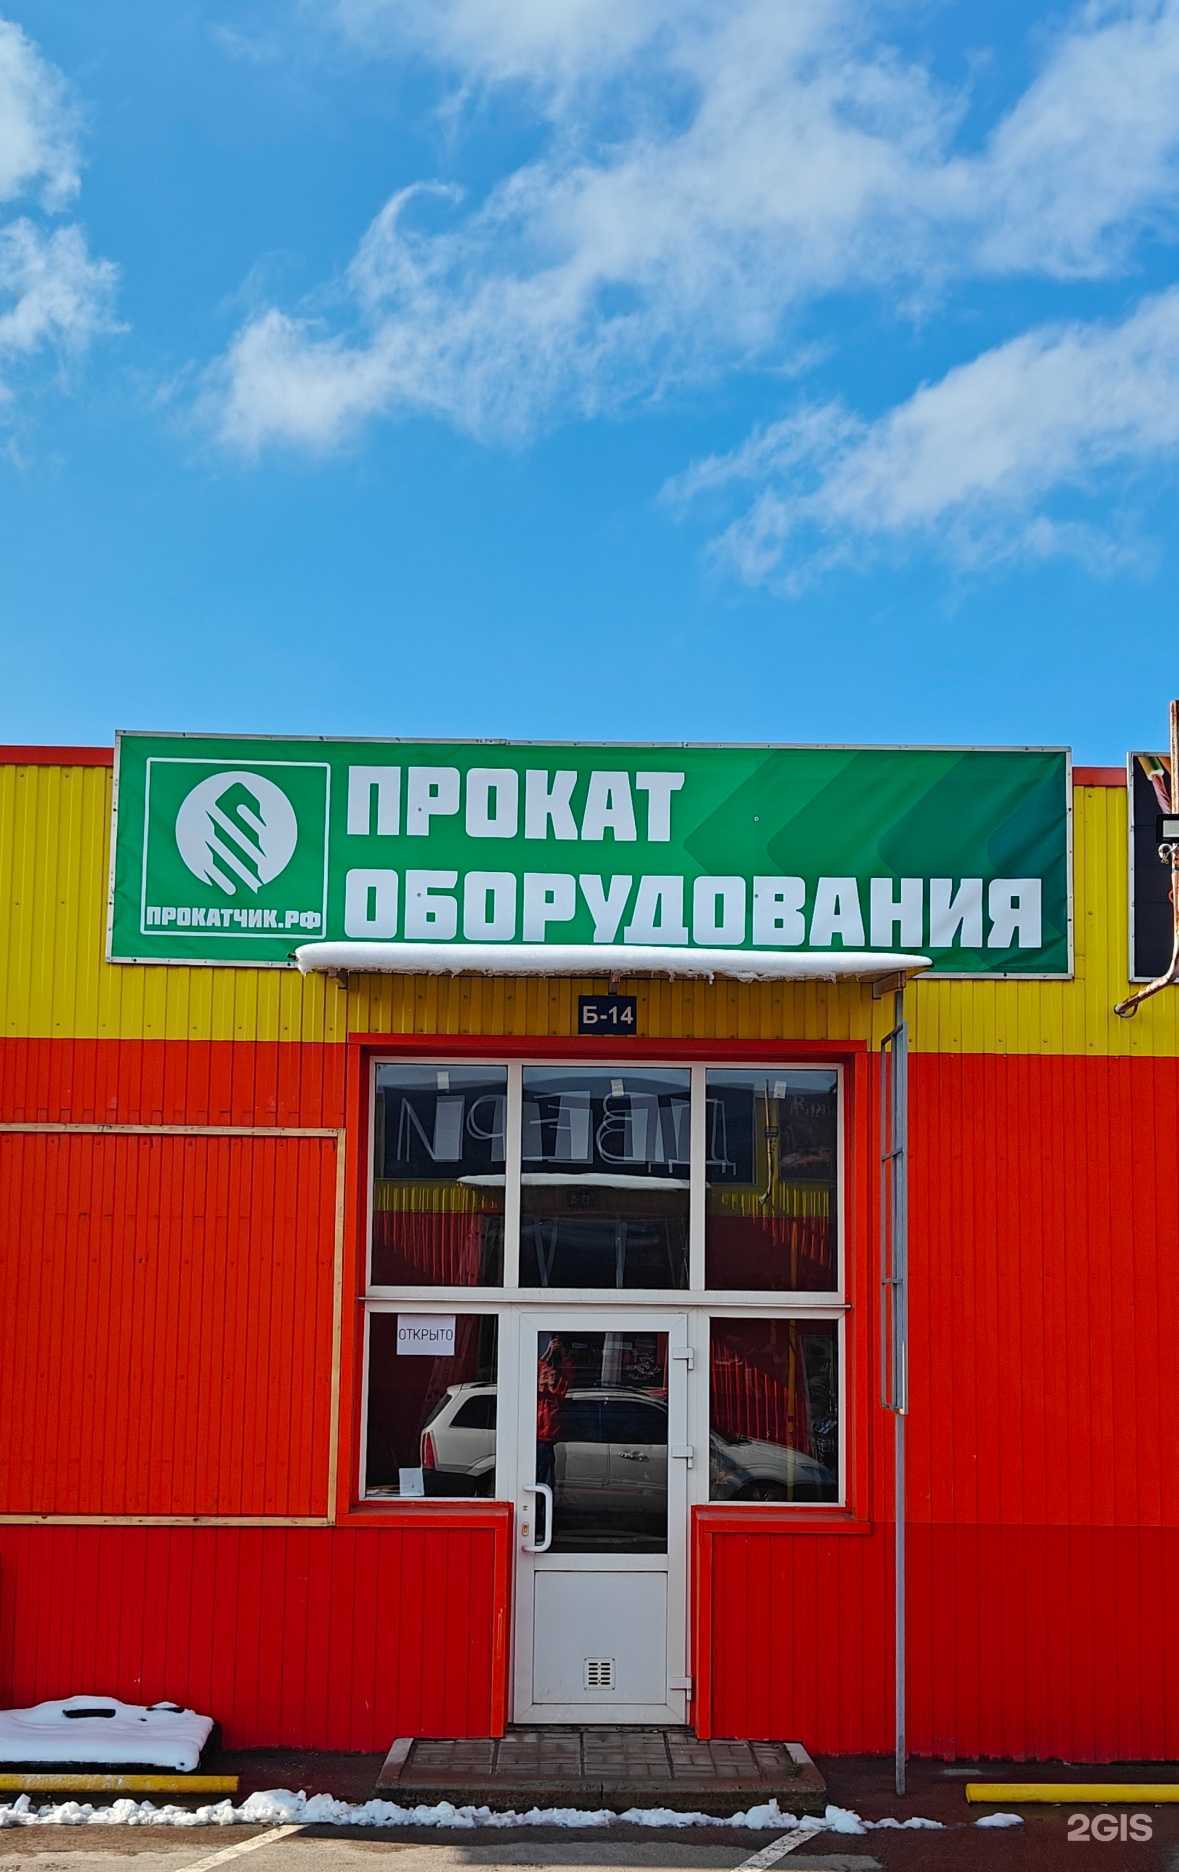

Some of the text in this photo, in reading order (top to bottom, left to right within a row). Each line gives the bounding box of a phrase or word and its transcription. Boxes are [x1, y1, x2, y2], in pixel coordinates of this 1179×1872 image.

[346, 765, 685, 842] ПРОКАТ
[146, 906, 321, 929] ПРОКАТЧИК.РФ
[344, 868, 1042, 948] ОБОРУДОВАНИЯ
[583, 1005, 634, 1025] Б-14
[398, 1328, 454, 1341] ОТКРЫТО
